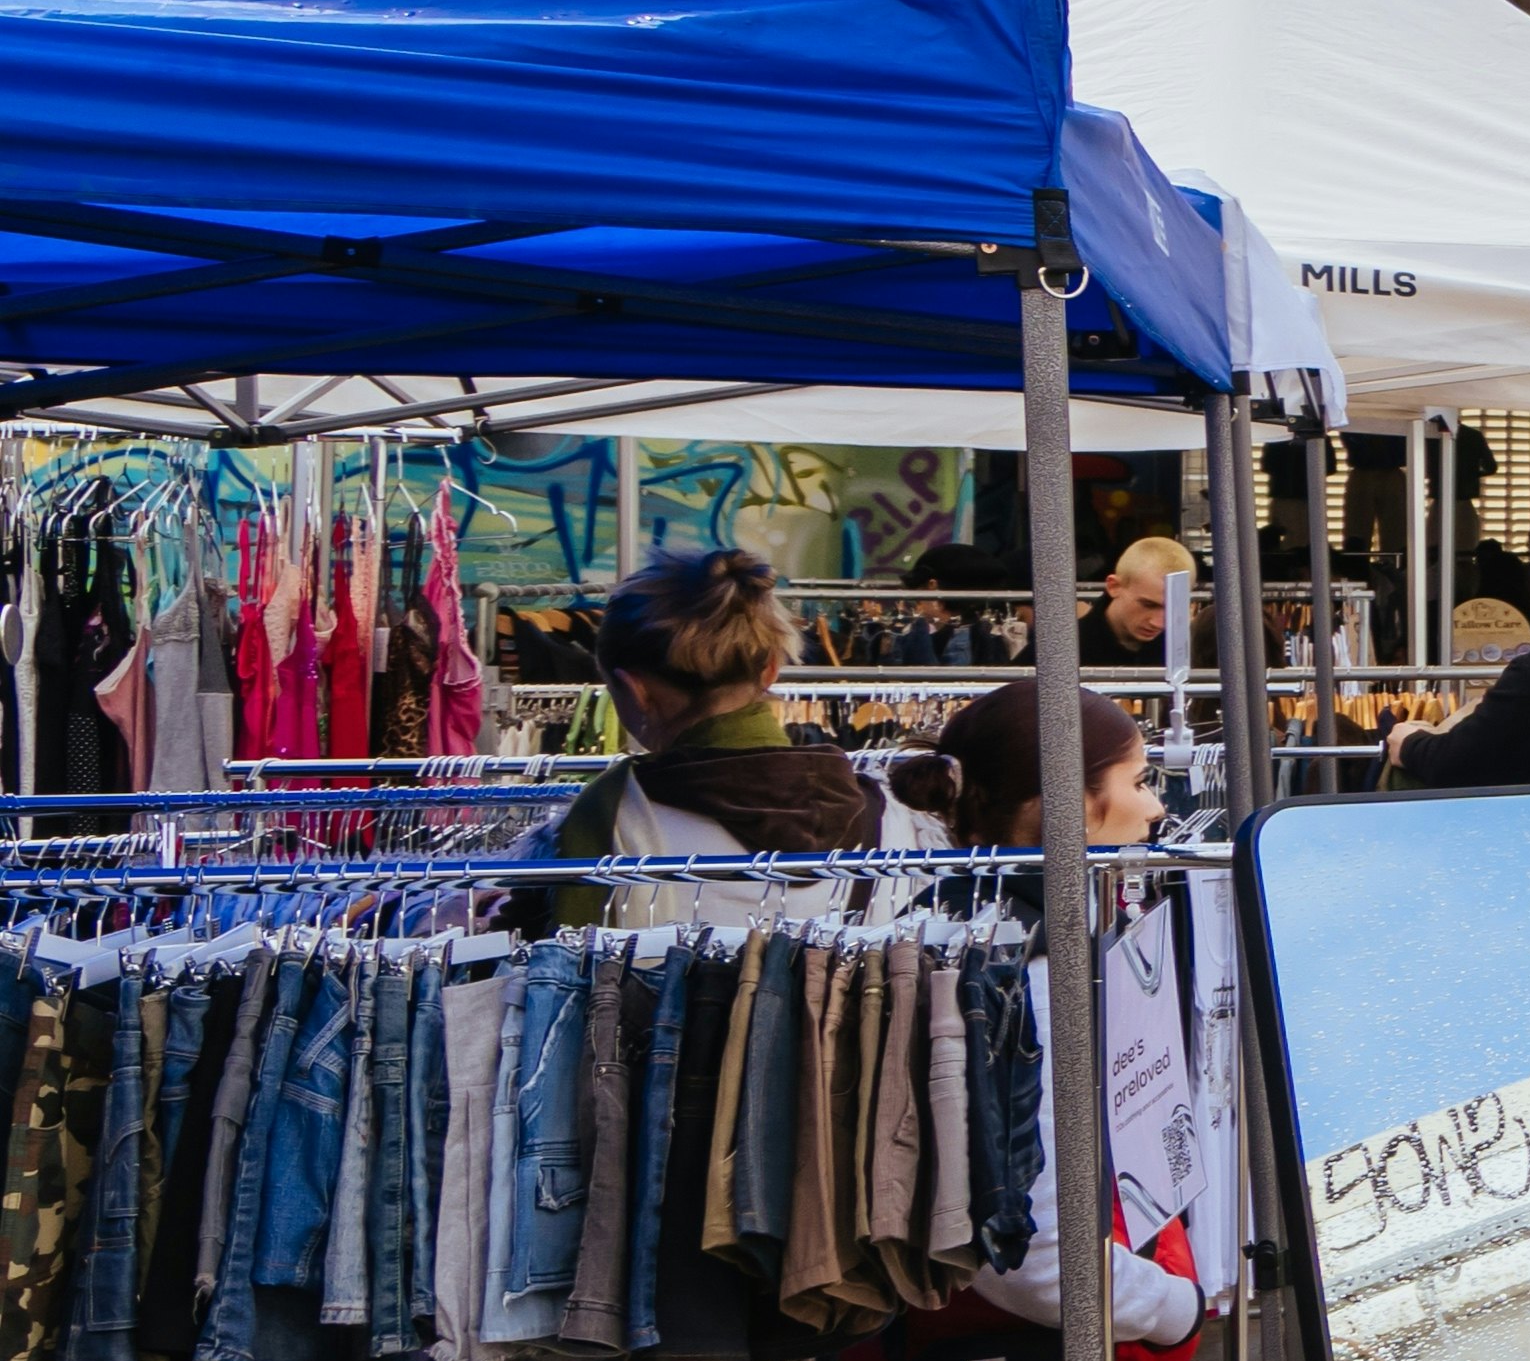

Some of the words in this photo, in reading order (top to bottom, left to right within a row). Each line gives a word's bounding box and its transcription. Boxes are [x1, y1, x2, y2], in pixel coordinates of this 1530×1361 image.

[1301, 263, 1418, 298] MILLS
[1112, 1037, 1145, 1077] dee's
[1113, 1046, 1172, 1115] preloved
